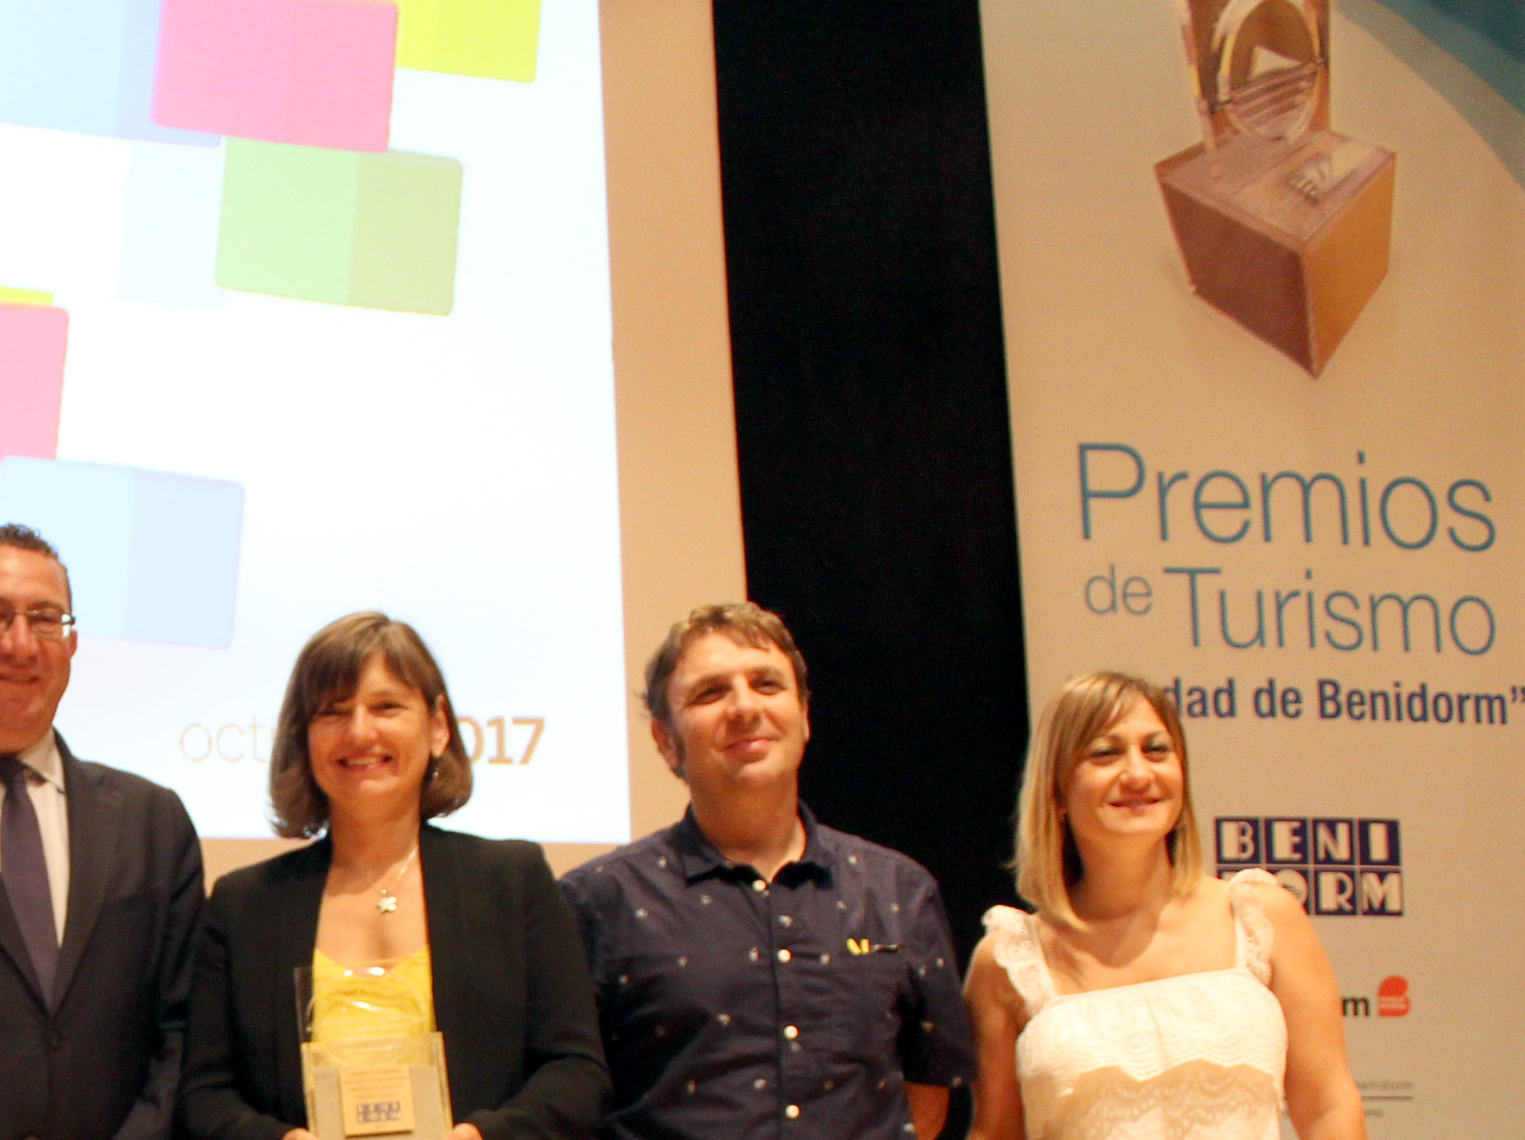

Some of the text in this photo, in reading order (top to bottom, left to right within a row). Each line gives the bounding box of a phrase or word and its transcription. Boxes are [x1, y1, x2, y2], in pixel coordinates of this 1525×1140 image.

[1077, 442, 1496, 552] Premios
[1084, 564, 1496, 656] de Turismo
[1163, 676, 1525, 724] dad de Benidorm”
[179, 712, 276, 764] oct
[457, 715, 546, 766] 017
[1217, 819, 1399, 863] BENI
[1219, 868, 1404, 914] ORM
